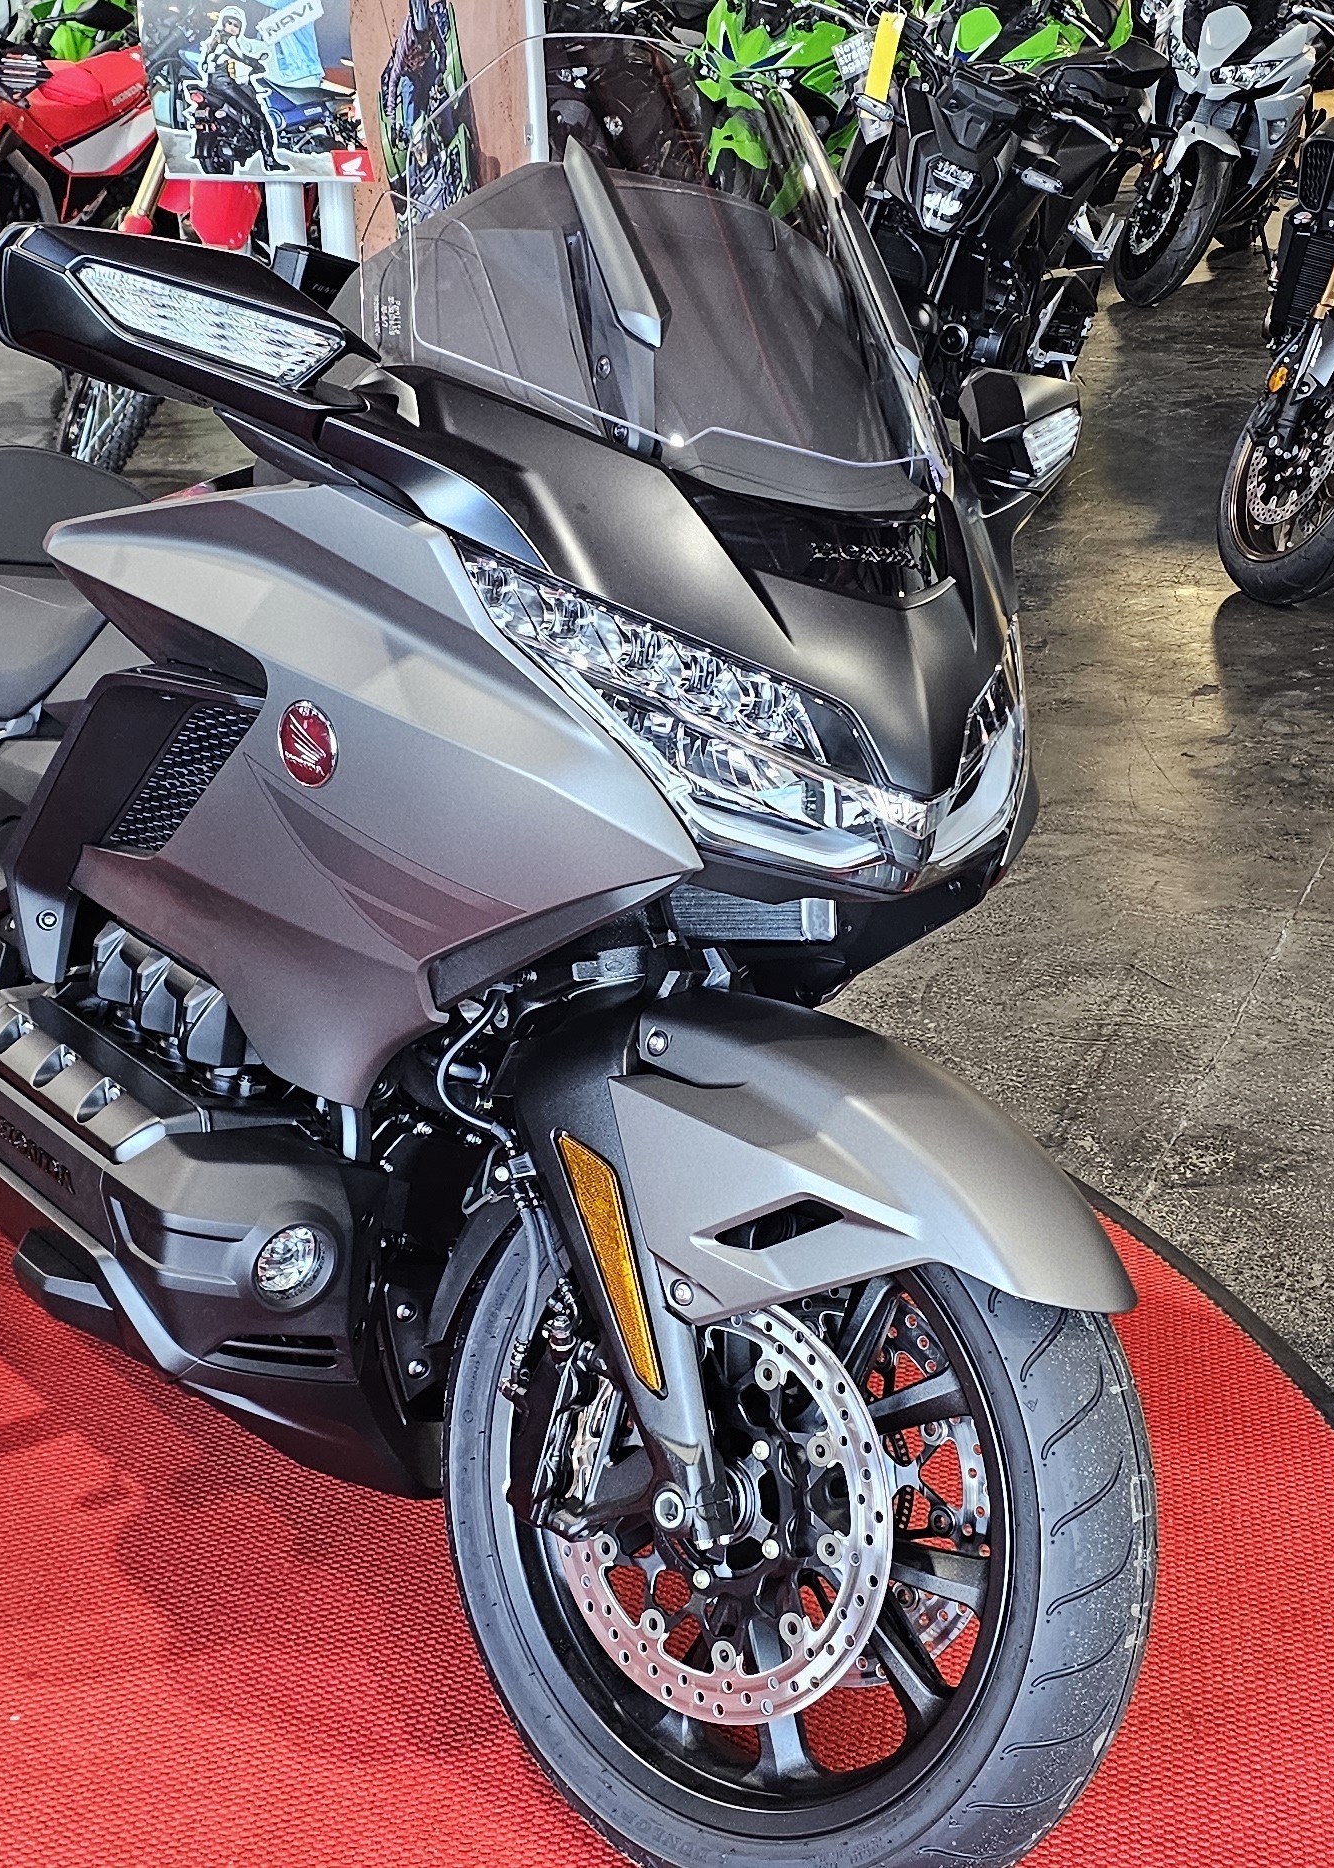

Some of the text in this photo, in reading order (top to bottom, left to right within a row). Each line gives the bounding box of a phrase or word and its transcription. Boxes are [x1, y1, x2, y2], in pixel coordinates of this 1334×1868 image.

[266, 2, 314, 37] NAVI
[834, 36, 865, 57] Never
[838, 41, 875, 66] strande
